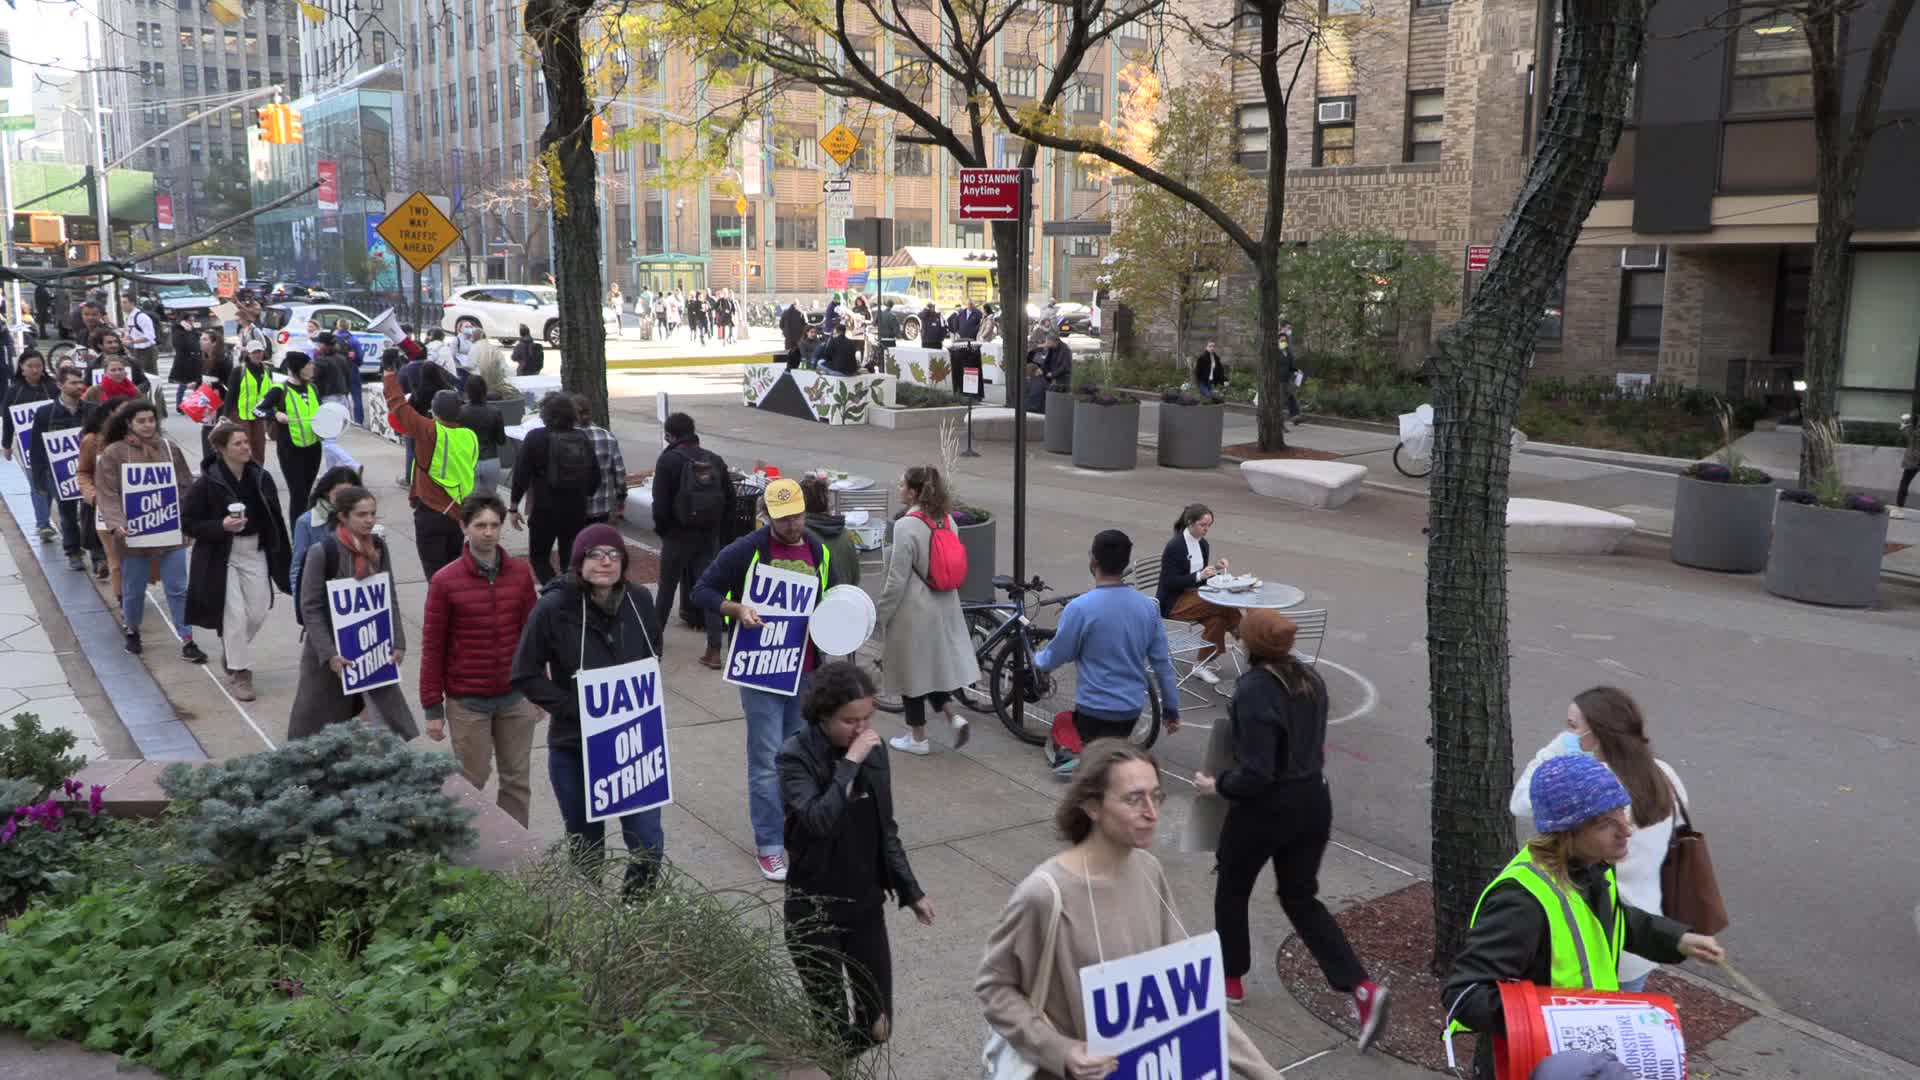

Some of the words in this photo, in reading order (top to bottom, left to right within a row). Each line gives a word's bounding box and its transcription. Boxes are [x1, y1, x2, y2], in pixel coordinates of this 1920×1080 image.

[963, 174, 976, 184] NO
[963, 185, 1000, 197] Anytime
[409, 207, 429, 217] TWO
[409, 220, 428, 229] WAY
[400, 230, 438, 241] TRAFFIC
[403, 243, 434, 254] AHEAD
[208, 262, 239, 272] FedEx
[361, 343, 378, 357] PD
[127, 465, 172, 487] UAW
[141, 490, 162, 513] ON
[127, 502, 178, 536] STRIKE
[332, 582, 386, 616] UAW
[750, 575, 814, 614] UAW
[358, 620, 378, 651] ON
[759, 620, 789, 648] ON
[345, 638, 392, 687] STRIKE
[731, 647, 800, 677] STRIKE
[584, 671, 656, 719] UAW
[615, 722, 644, 766] ON
[593, 745, 665, 813] STRIKE
[1092, 955, 1213, 1039] UAW
[1136, 1036, 1182, 1080] ON
[1638, 1032, 1660, 1080] ARDSHIP
[1660, 1058, 1678, 1080] UND
